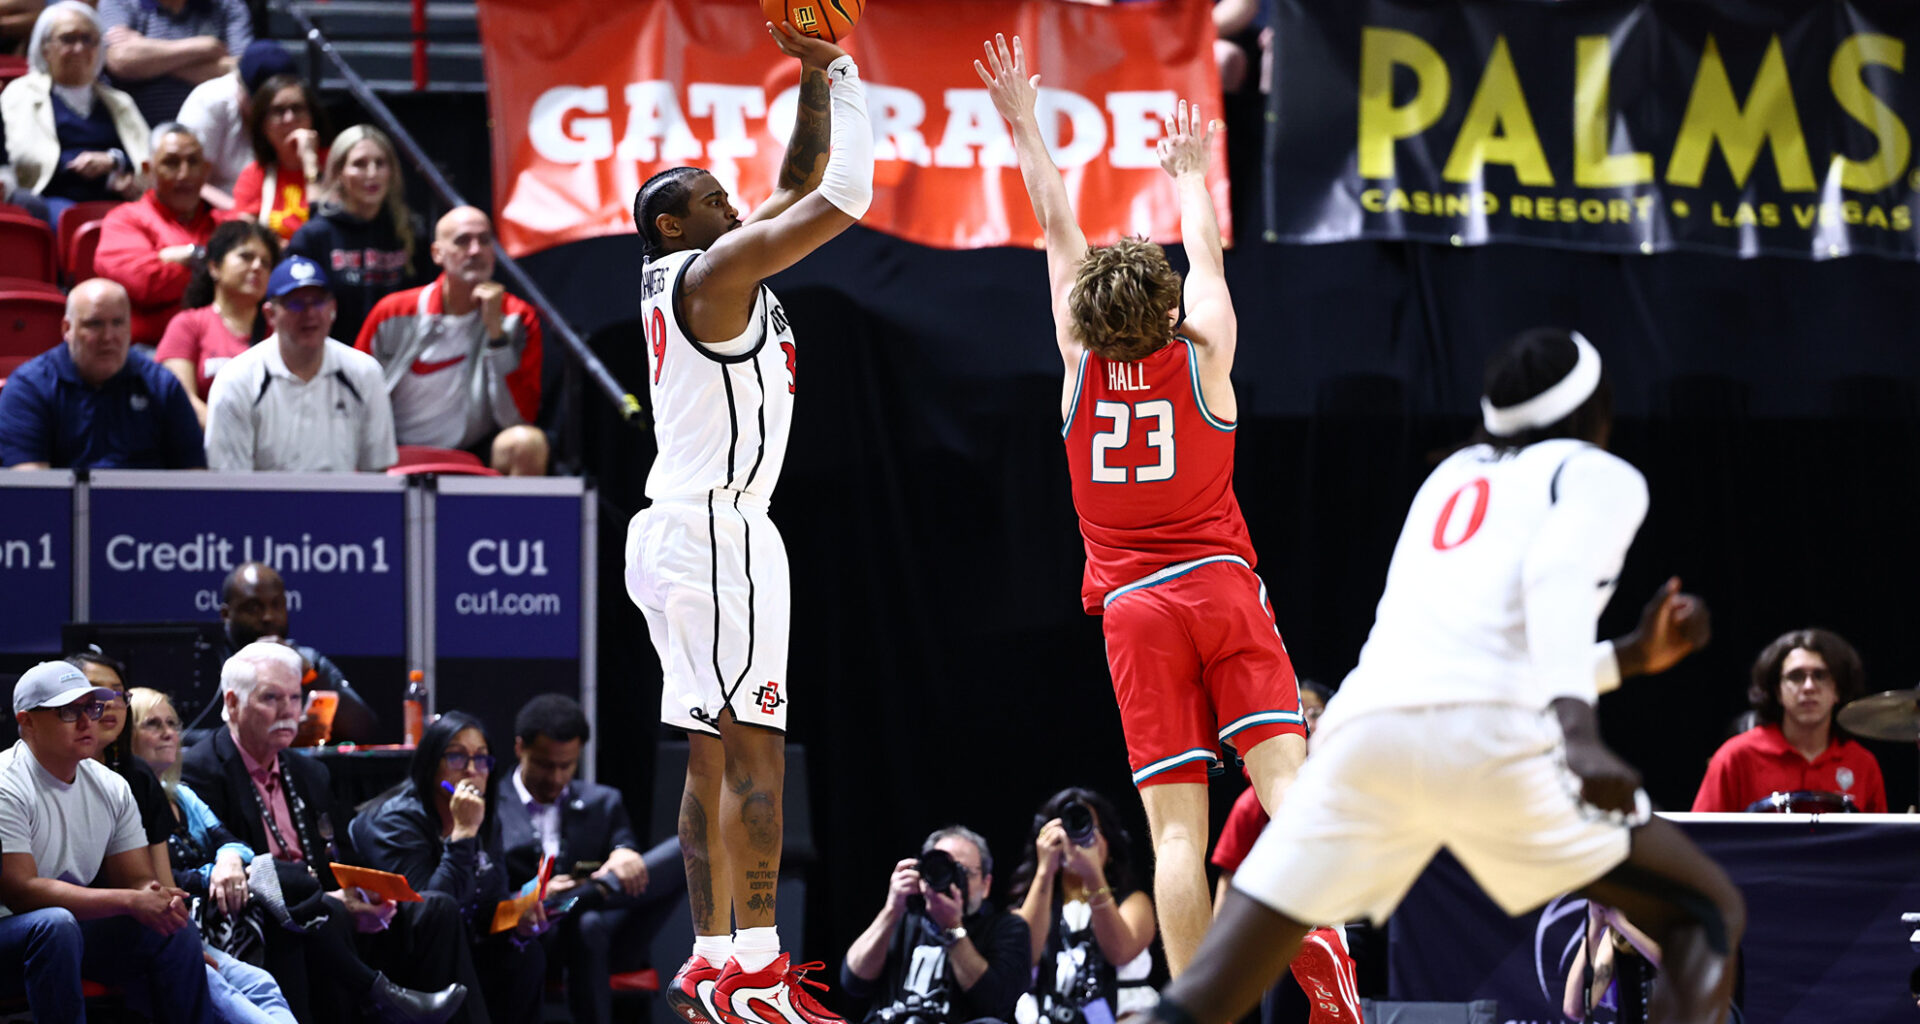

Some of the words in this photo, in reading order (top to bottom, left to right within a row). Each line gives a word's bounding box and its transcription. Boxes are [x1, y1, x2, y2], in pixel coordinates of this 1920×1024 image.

[1358, 27, 1911, 193] PALMS
[1361, 188, 1499, 216] CASINO
[1511, 194, 1653, 223] RESORT
[1712, 202, 1781, 228] LAS
[1792, 204, 1912, 231] VEGAS
[1108, 362, 1150, 391] HALL
[1091, 399, 1176, 483] 23
[1432, 477, 1490, 551] 0
[106, 533, 234, 571] Credit
[468, 539, 548, 576] CU1
[455, 589, 560, 615] cu1.com
